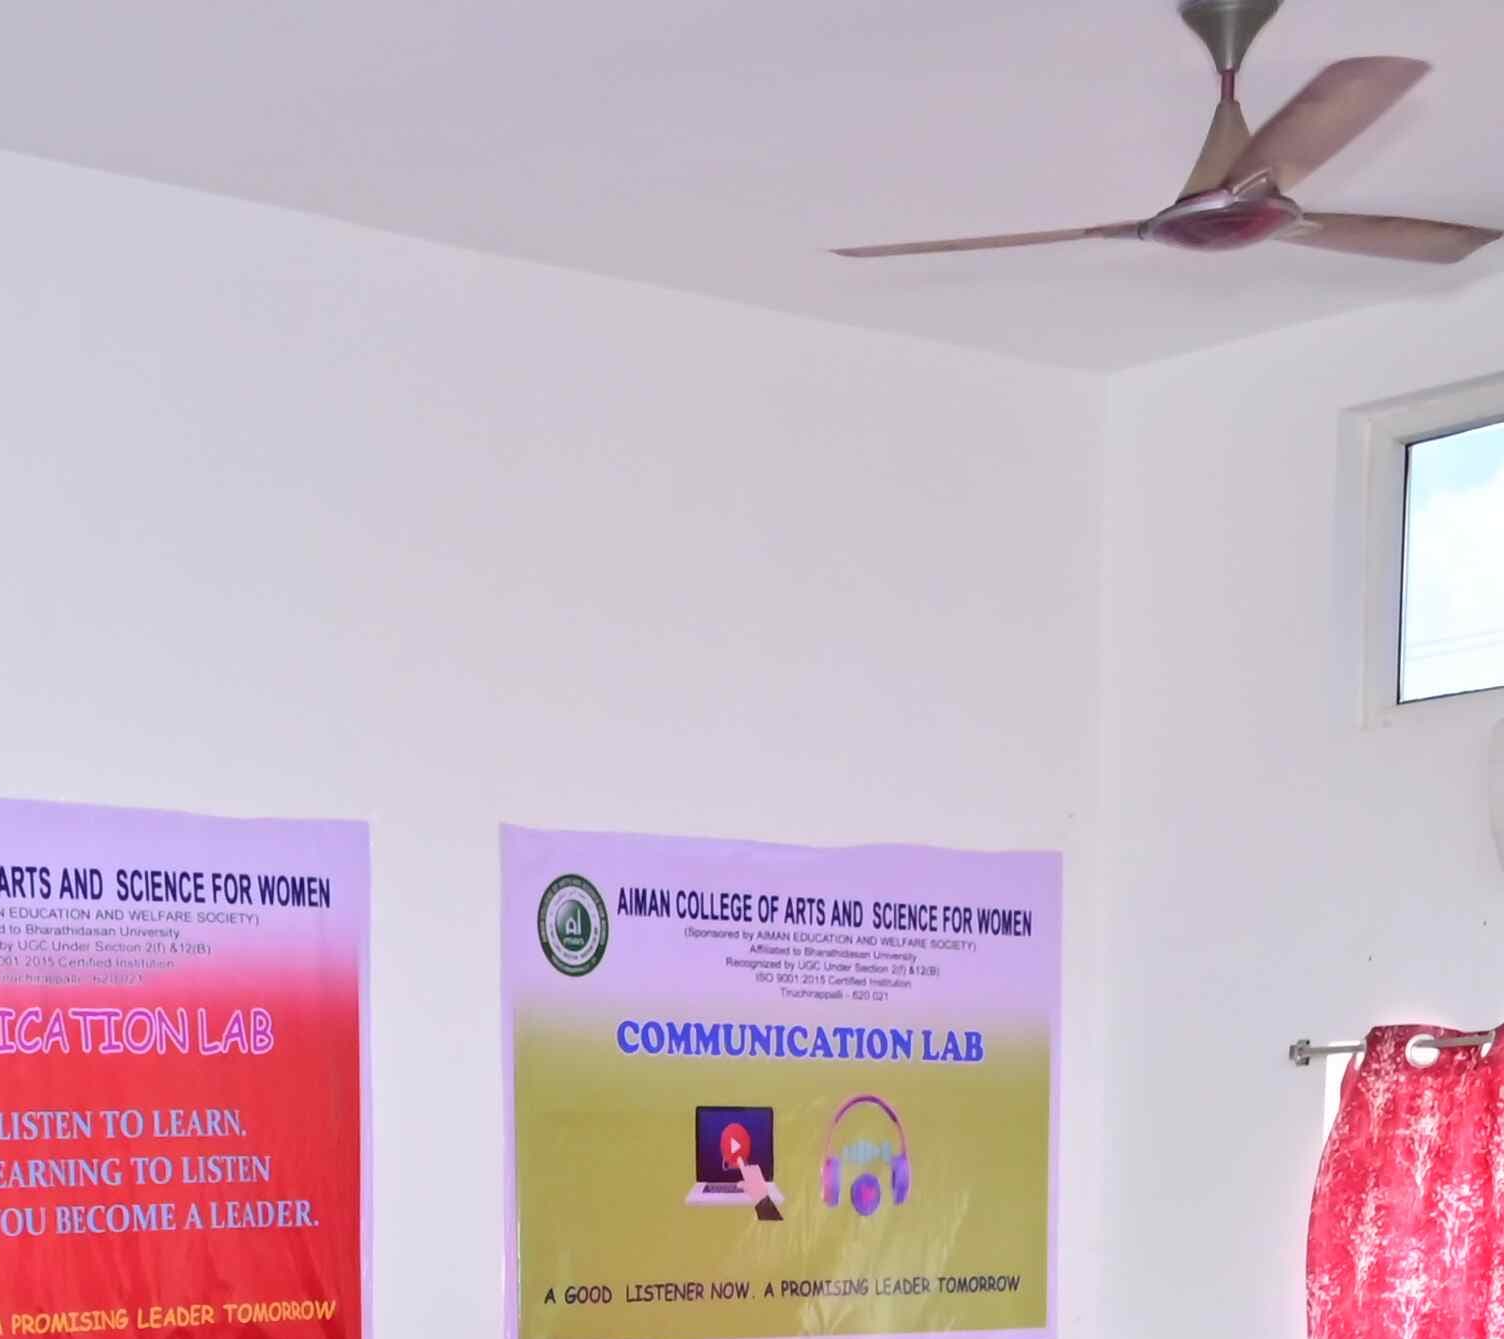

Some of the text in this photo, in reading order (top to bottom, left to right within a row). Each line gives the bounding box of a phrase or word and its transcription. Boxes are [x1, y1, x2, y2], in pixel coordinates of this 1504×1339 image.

[59, 866, 103, 902] AND
[115, 868, 206, 904] SCIENCE
[211, 872, 253, 906] FOR
[257, 874, 332, 908] WOMEN
[617, 887, 1033, 937] AIMAN COLLEGE OF ARTS AND SCIENCE FOR WOMEN
[198, 1008, 274, 1054] LAB
[616, 1020, 984, 1062] COMMUNICATION LAB
[100, 1110, 144, 1139] TO
[151, 1108, 248, 1138] LEARN.
[130, 1156, 174, 1187] TO
[181, 1154, 271, 1185] LISTEN
[55, 1204, 177, 1235] BECOME
[182, 1202, 203, 1230] A
[208, 1198, 320, 1230] LEADER.
[544, 1288, 556, 1304] A
[564, 1285, 612, 1304] GOOD
[625, 1281, 705, 1302] LISTENER
[764, 1282, 775, 1297] A
[781, 1279, 869, 1297] PROMISING
[875, 1277, 931, 1296] LEADER
[937, 1274, 1021, 1294] TOMORROW
[10, 1310, 130, 1335] PROMISING
[136, 1305, 215, 1330] LEADER
[222, 1299, 337, 1323] TOMORROW
